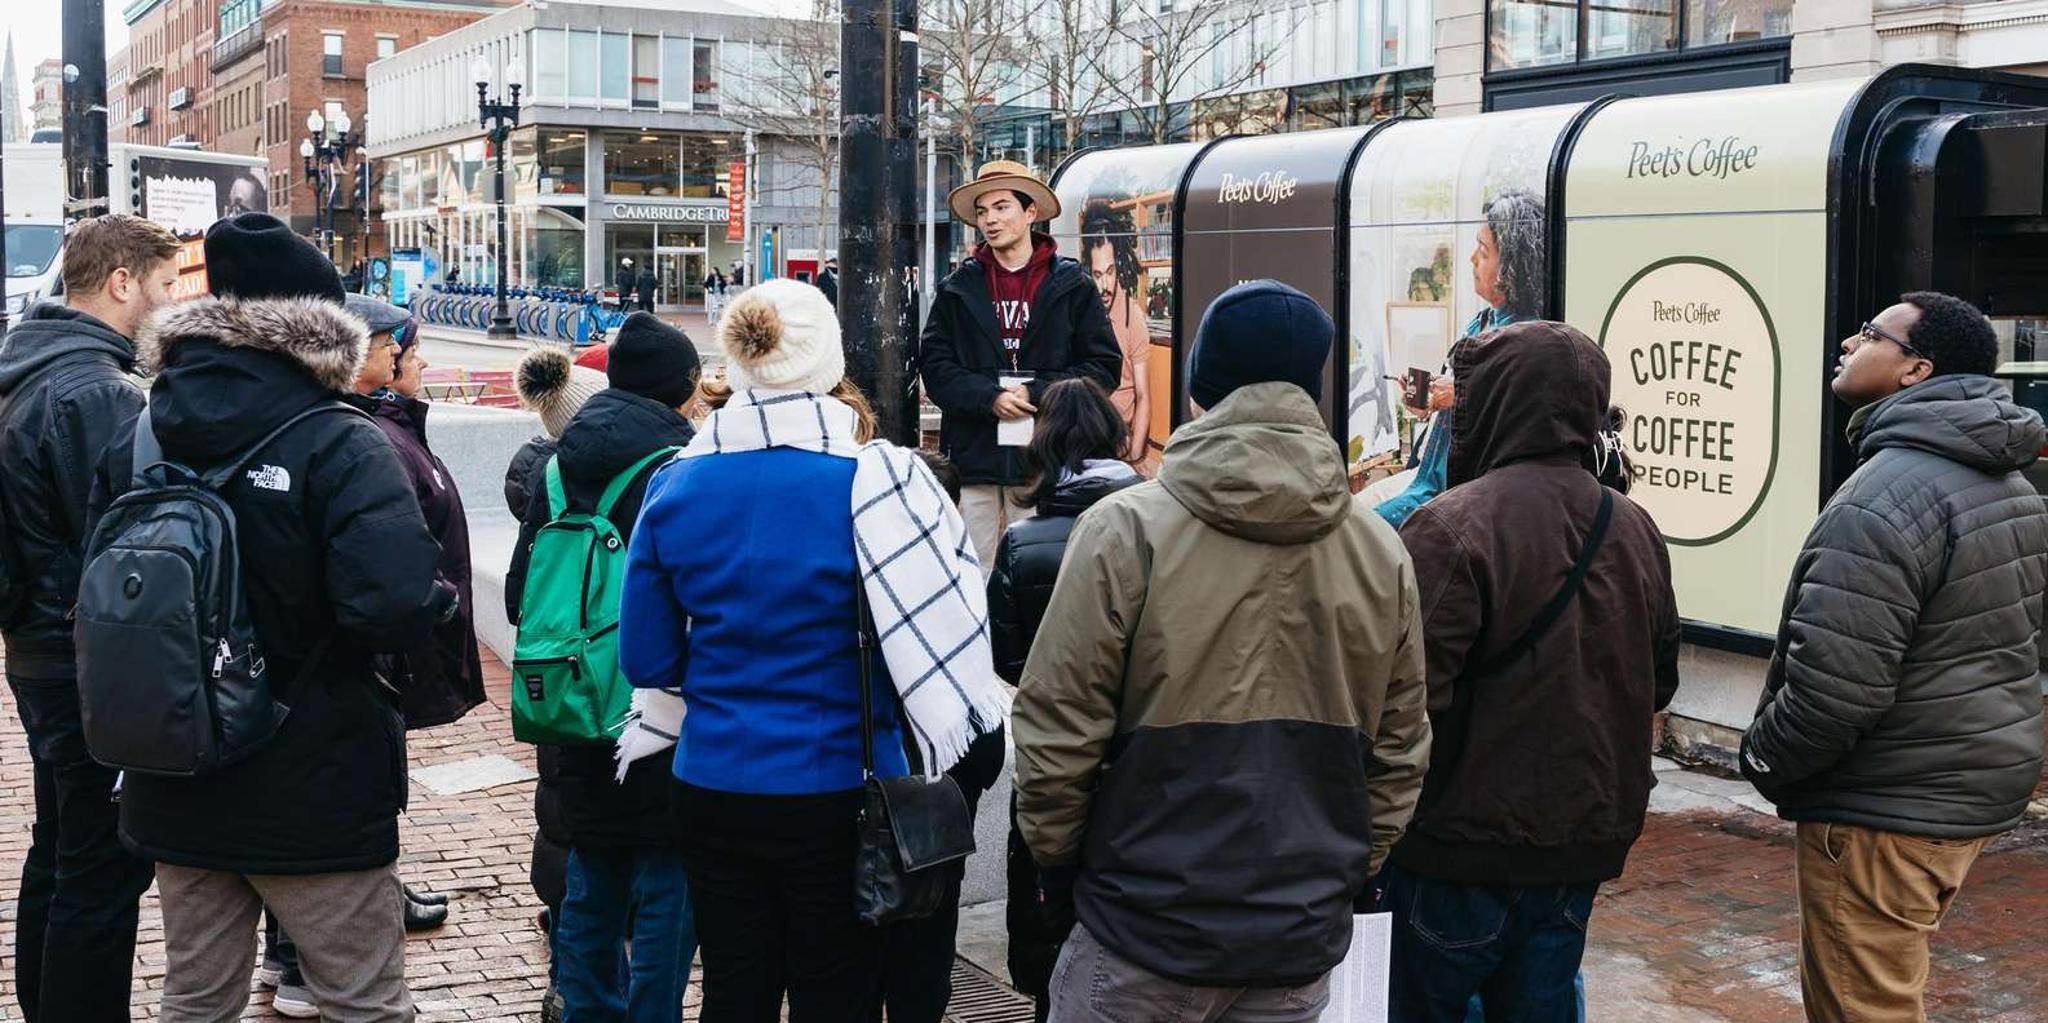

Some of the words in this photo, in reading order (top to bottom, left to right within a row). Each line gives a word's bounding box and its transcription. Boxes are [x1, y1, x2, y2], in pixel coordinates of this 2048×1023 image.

[1687, 136, 1758, 180] Coffee
[1253, 169, 1298, 204] Coffee
[1684, 302, 1721, 326] Coffee
[1630, 341, 1742, 391] COFFEE
[1665, 391, 1701, 407] FOR
[1633, 415, 1735, 462] COFFEE
[246, 469, 276, 482] NORTH
[262, 464, 279, 474] THE
[1632, 464, 1733, 495] PEOPLE
[253, 478, 276, 488] FACE
